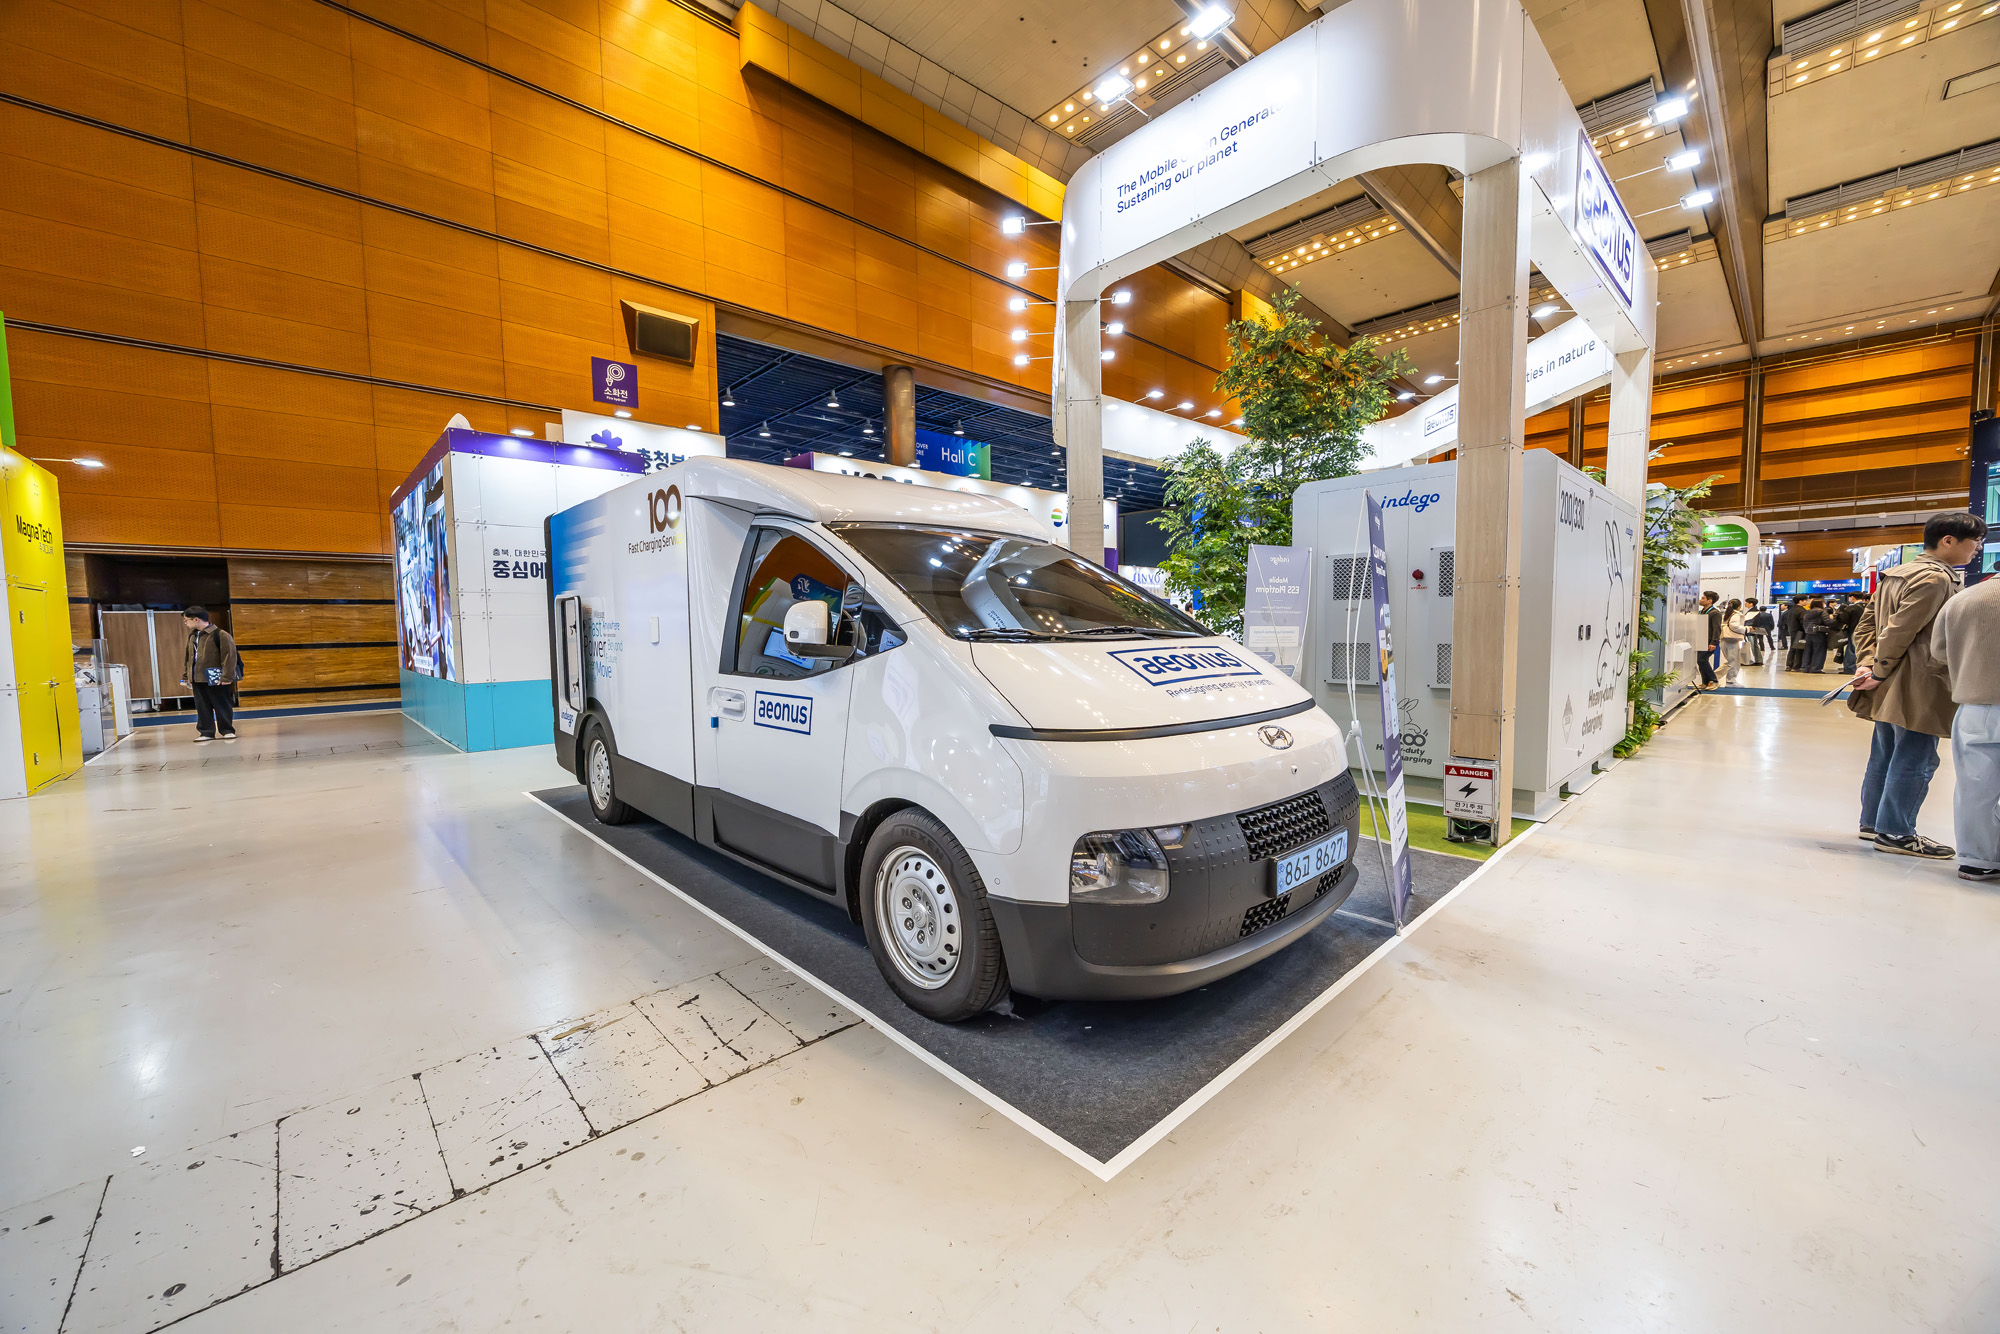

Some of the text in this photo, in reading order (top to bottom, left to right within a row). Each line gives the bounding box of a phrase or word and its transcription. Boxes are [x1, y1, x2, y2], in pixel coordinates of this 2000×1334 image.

[1117, 182, 1137, 198] The
[1139, 156, 1178, 187] Mobile
[1117, 176, 1172, 214] Sustaning
[1174, 165, 1195, 183] our
[1197, 140, 1238, 174] planet
[1582, 168, 1631, 282] aeonus
[1546, 360, 1556, 374] in
[1557, 338, 1596, 368] nature
[603, 386, 628, 399] 소화전
[941, 446, 965, 465] Hall
[967, 452, 977, 467] C
[647, 484, 682, 535] 100
[1380, 489, 1441, 513] indego
[1559, 489, 1586, 533] 200/330
[16, 514, 53, 543] MagnaTech
[492, 548, 547, 558] 충북, 대한민국
[628, 532, 683, 555] Fast Charging Service
[492, 559, 547, 580] 중심에
[584, 635, 606, 658] Power
[596, 660, 612, 679] Move
[1133, 651, 1243, 675] aeonus
[1166, 683, 1222, 698] Redesigning
[1219, 681, 1248, 691] energy
[758, 699, 808, 725] aeonus
[1460, 769, 1489, 777] DANGER
[900, 827, 946, 862] NEXEN
[1285, 836, 1343, 886] 86고 8627
